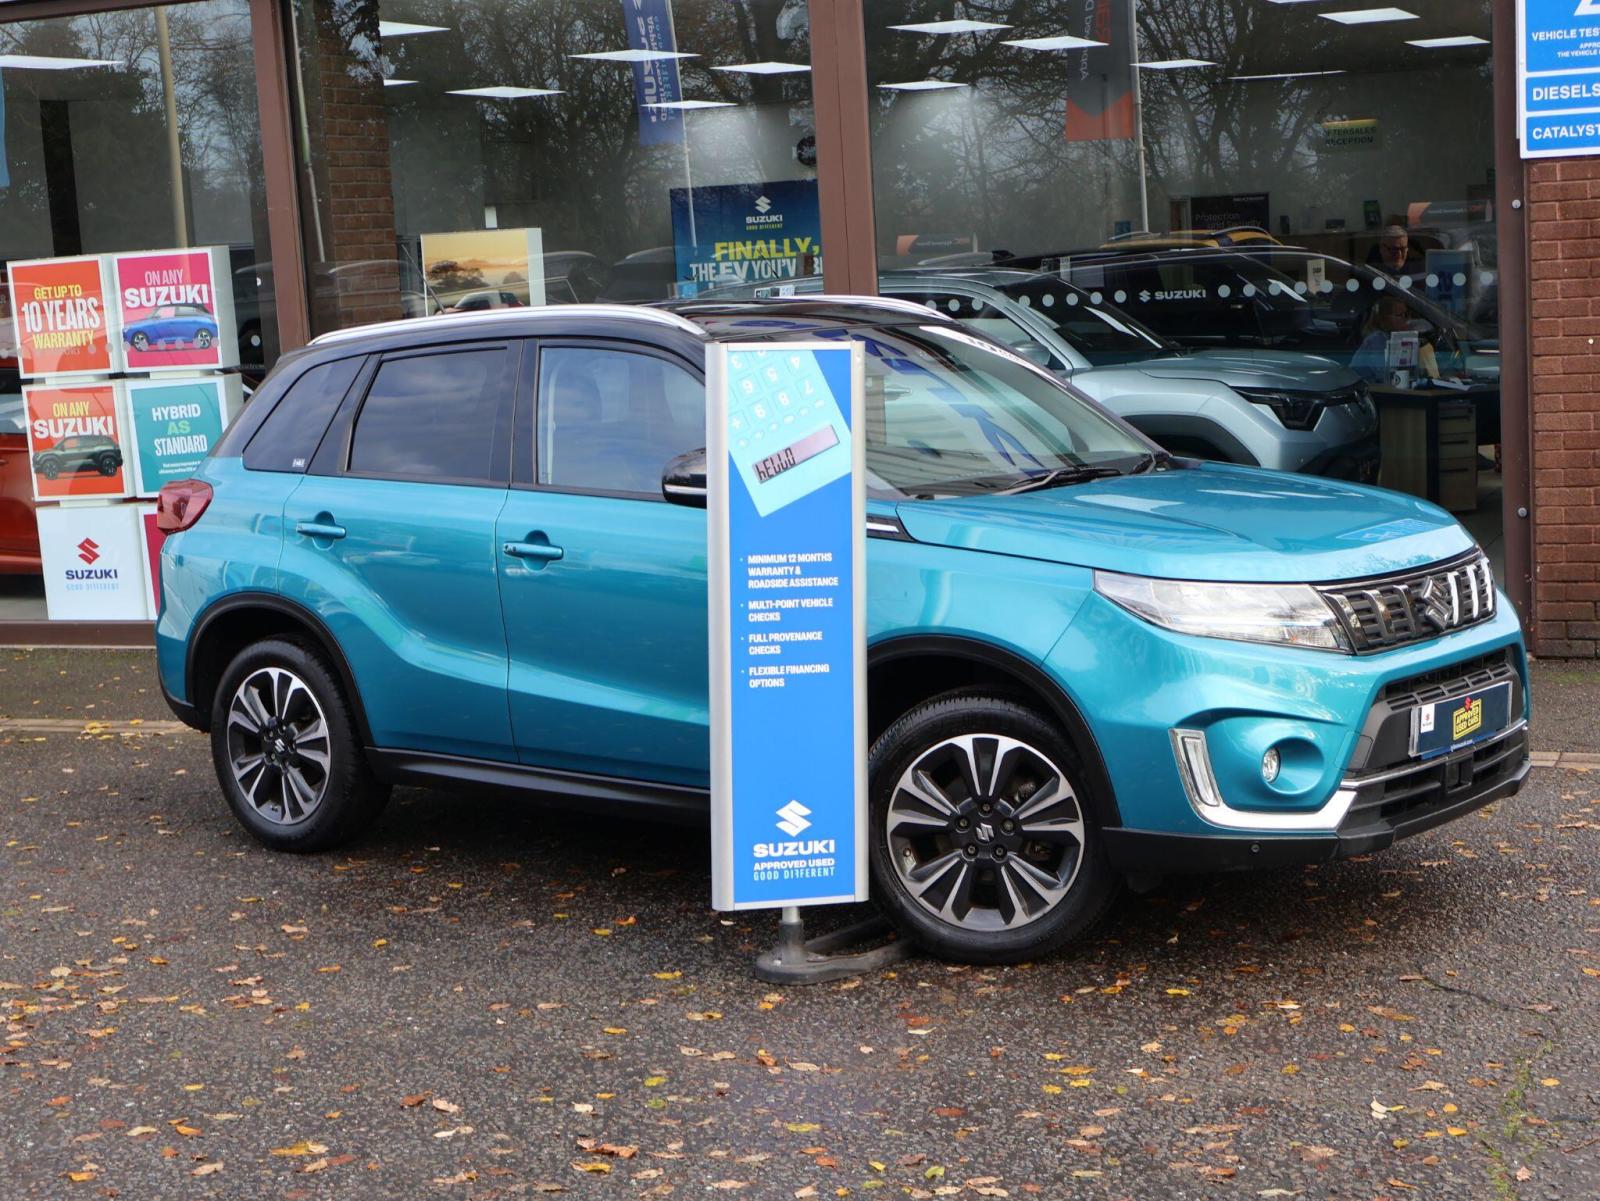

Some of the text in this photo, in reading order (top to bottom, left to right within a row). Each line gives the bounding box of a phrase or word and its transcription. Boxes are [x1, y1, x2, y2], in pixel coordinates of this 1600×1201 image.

[1532, 29, 1577, 41] VEHICLE
[1571, 49, 1598, 57] VEHICLE
[745, 214, 783, 224] SUZUKI
[714, 236, 819, 261] FINALLY,
[144, 269, 184, 286] ON ANY
[689, 262, 717, 282] THE
[34, 284, 82, 300] GET UP TO
[124, 283, 209, 308] SUZUKI
[1154, 289, 1207, 300] SUZUKI
[21, 296, 100, 333] 10 YEARS
[32, 329, 94, 350] WARRANTY
[52, 400, 90, 417] ON ANY
[151, 403, 201, 421] HYBRID
[33, 415, 114, 439] SUZUKI
[167, 420, 191, 435] AS
[154, 434, 208, 457] STANDARD
[748, 552, 833, 565] MINIMUM 12 MONTHS
[65, 569, 118, 580] SUZUKI
[748, 566, 801, 577] WARRANTY &
[748, 577, 839, 589] ROADSIDE ASSISTANCE
[748, 598, 833, 610] MULTI-POINT VEHICLE
[748, 612, 781, 622] CHECKS
[748, 631, 823, 643] FULL PROVENANCE
[748, 645, 781, 655] CHECKS
[749, 664, 830, 676] FLEXIBLE FINANCING
[749, 678, 785, 688] OPTIONS
[753, 839, 835, 858] SUZUKI
[753, 858, 835, 871] APPROVED USED
[753, 867, 835, 881] GOOD DIFFERENT
